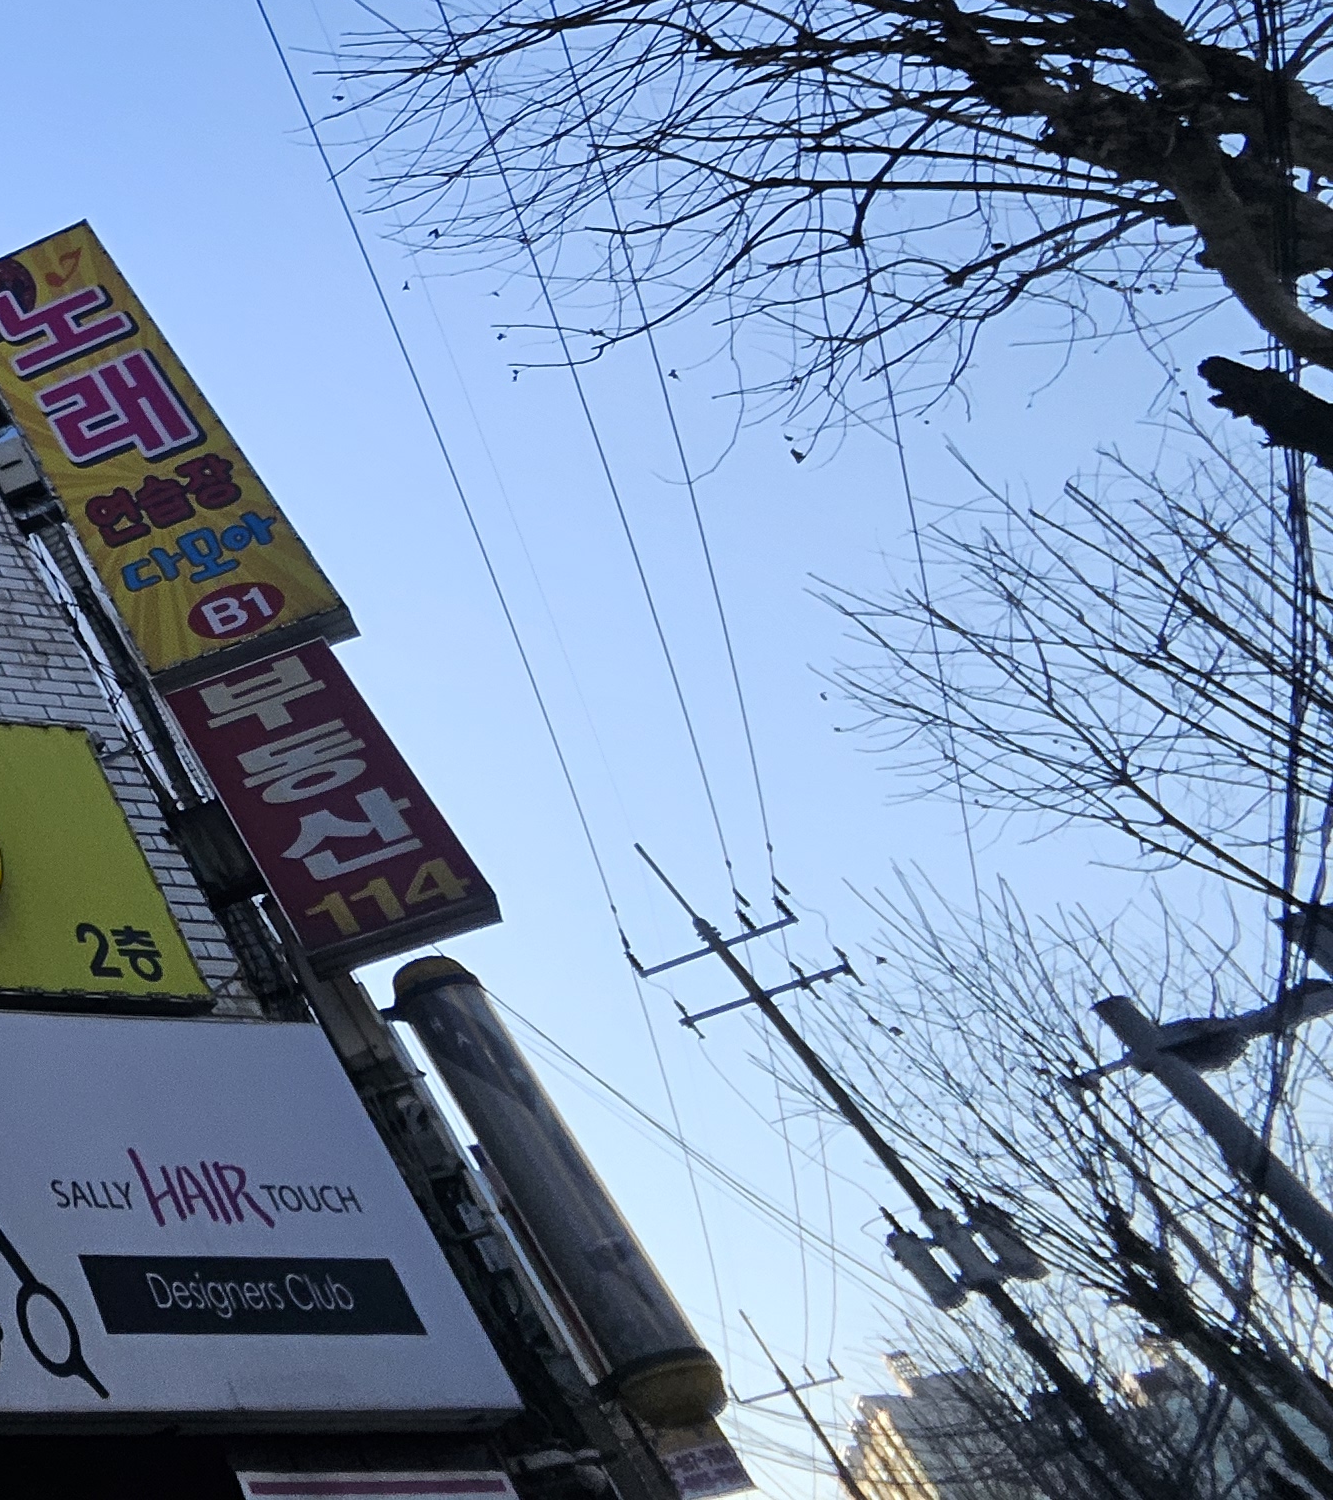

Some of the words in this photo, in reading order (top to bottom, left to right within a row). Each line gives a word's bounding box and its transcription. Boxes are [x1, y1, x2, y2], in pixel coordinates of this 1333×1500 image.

[85, 452, 242, 549] 연습장
[121, 511, 277, 592] 다모아
[200, 585, 274, 635] B1
[197, 654, 424, 882] 부동산
[304, 856, 473, 937] 114
[76, 921, 164, 983] 2층
[50, 1179, 135, 1211] SALLY
[127, 1147, 275, 1230] HAIR
[259, 1184, 365, 1214] TOUCH
[144, 1271, 284, 1320] Designers
[284, 1272, 356, 1312] Club
